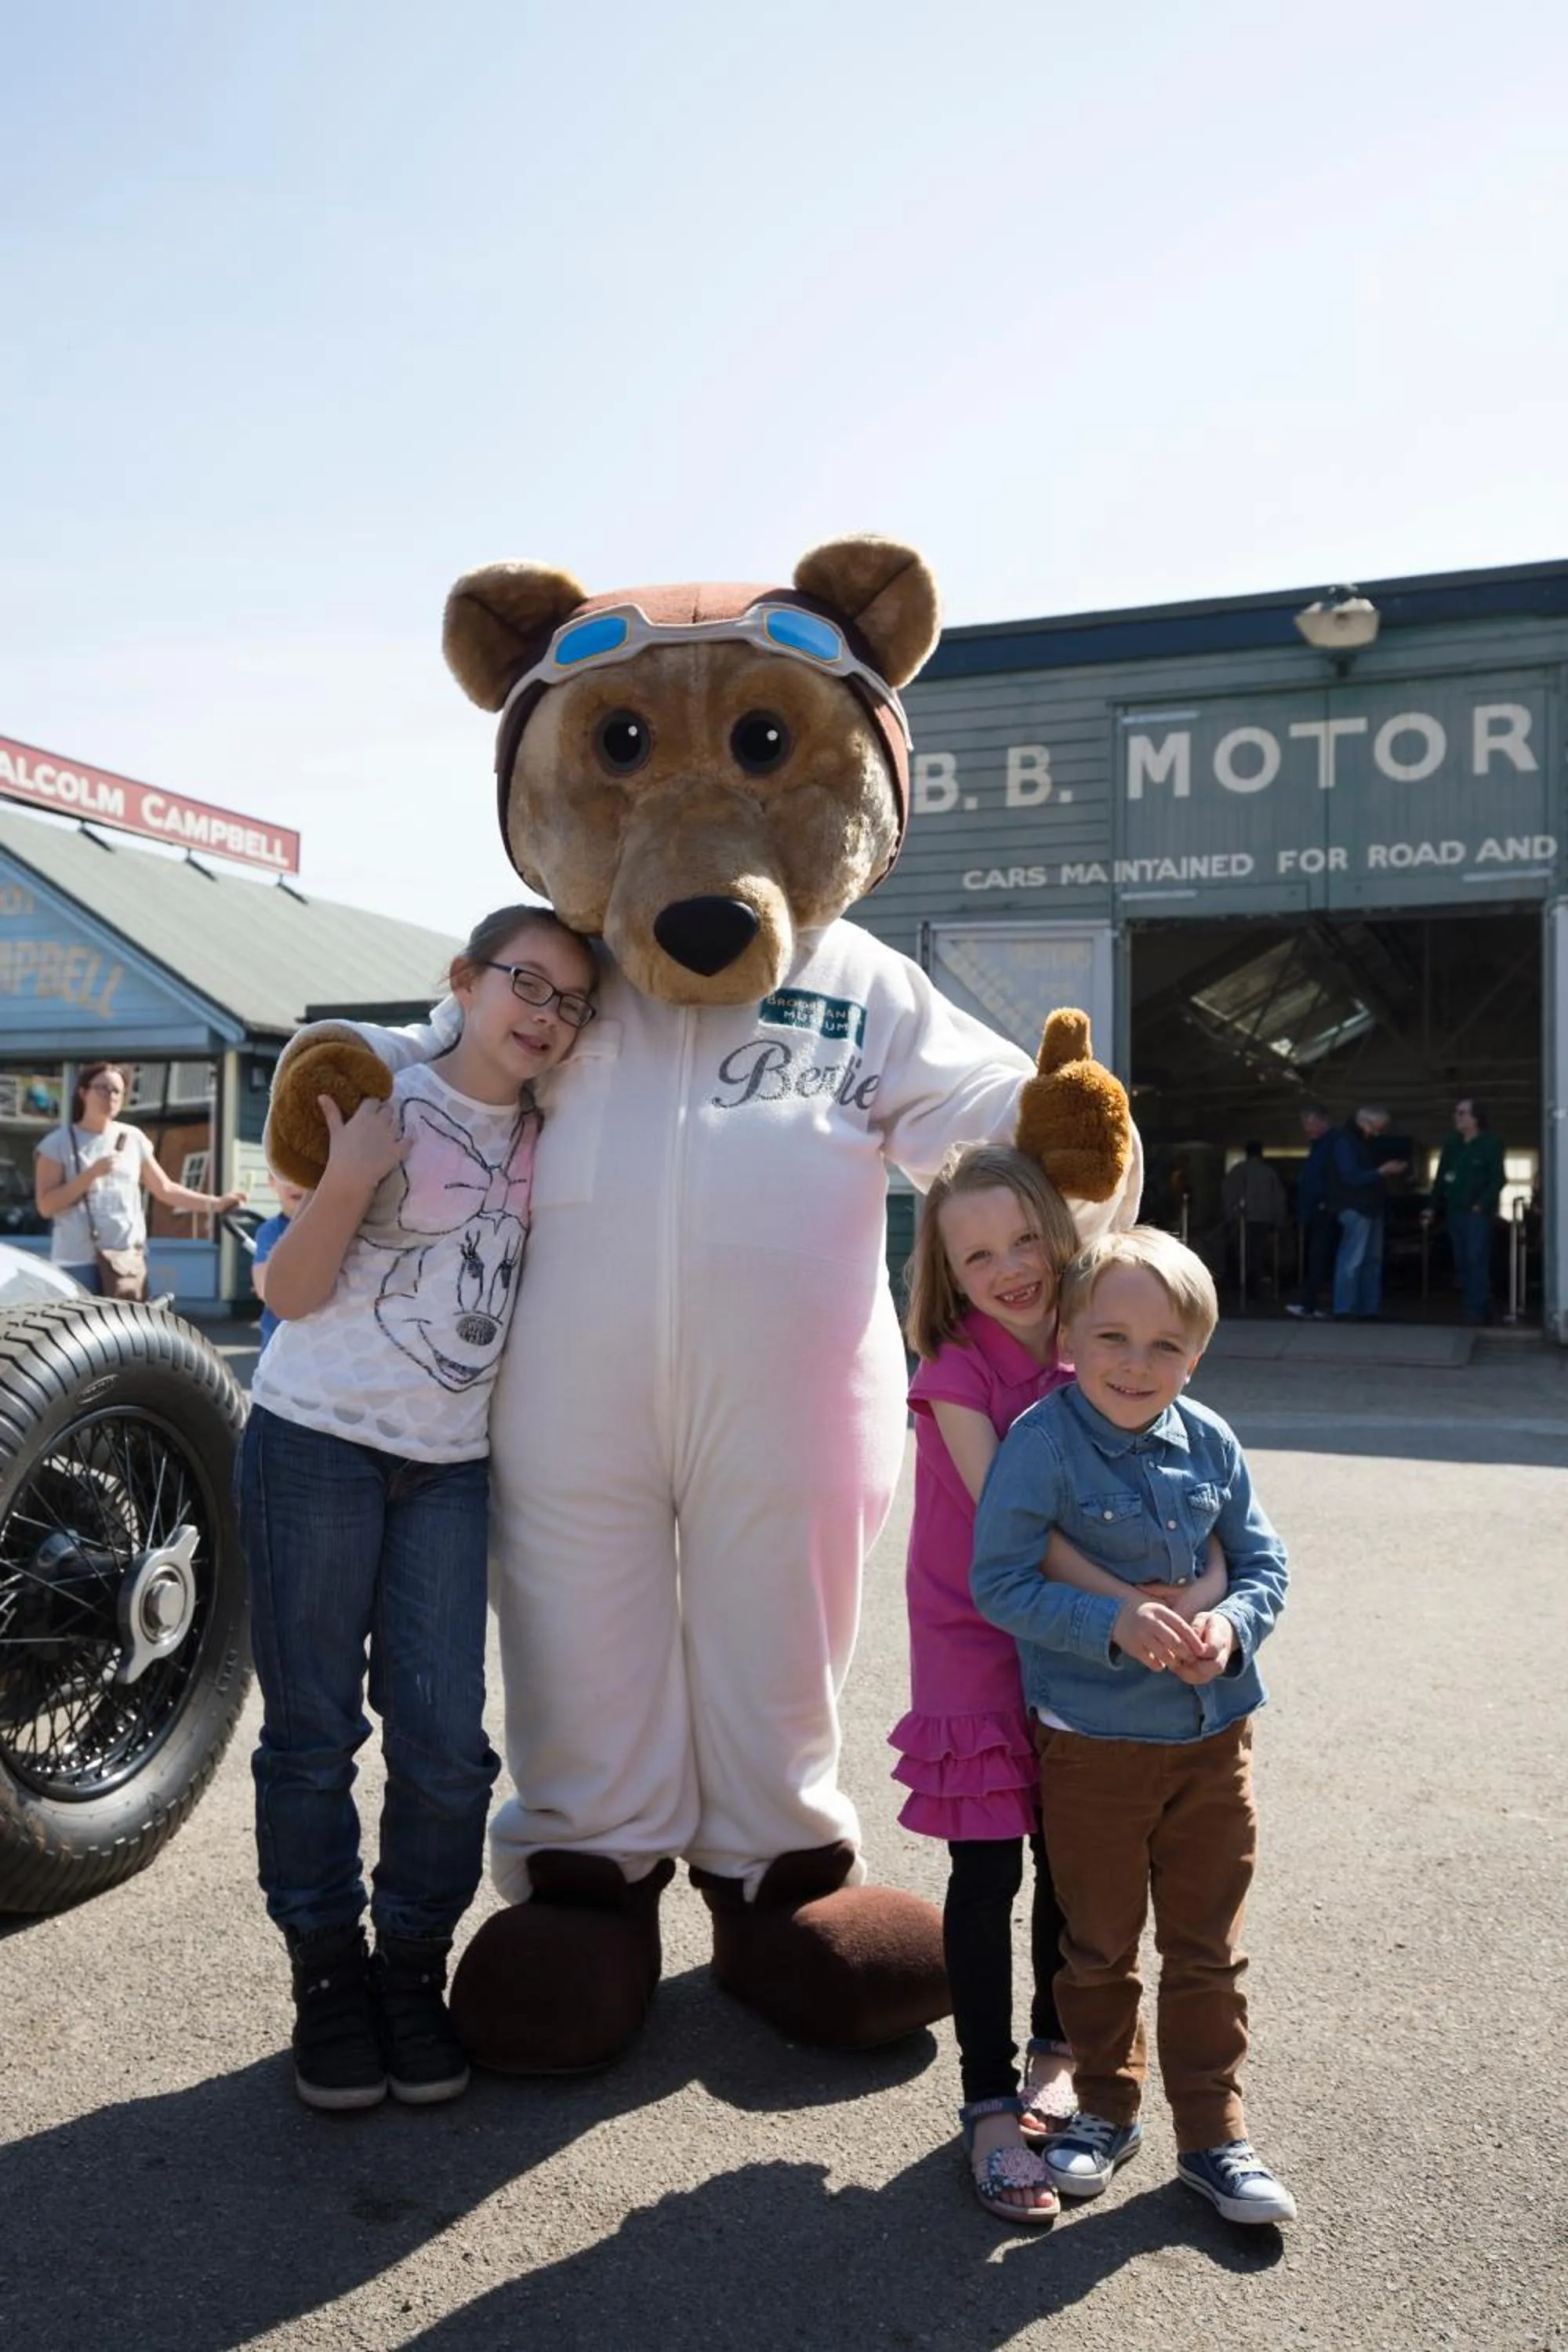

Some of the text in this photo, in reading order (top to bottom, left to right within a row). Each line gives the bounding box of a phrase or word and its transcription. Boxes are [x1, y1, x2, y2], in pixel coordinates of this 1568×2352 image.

[1127, 702, 1539, 800] MOTOR
[141, 793, 289, 867] CAMPBELL
[963, 865, 1046, 890] CARS
[1279, 847, 1348, 873] FOR
[1368, 840, 1465, 869] ROAD
[1475, 834, 1558, 863] AND
